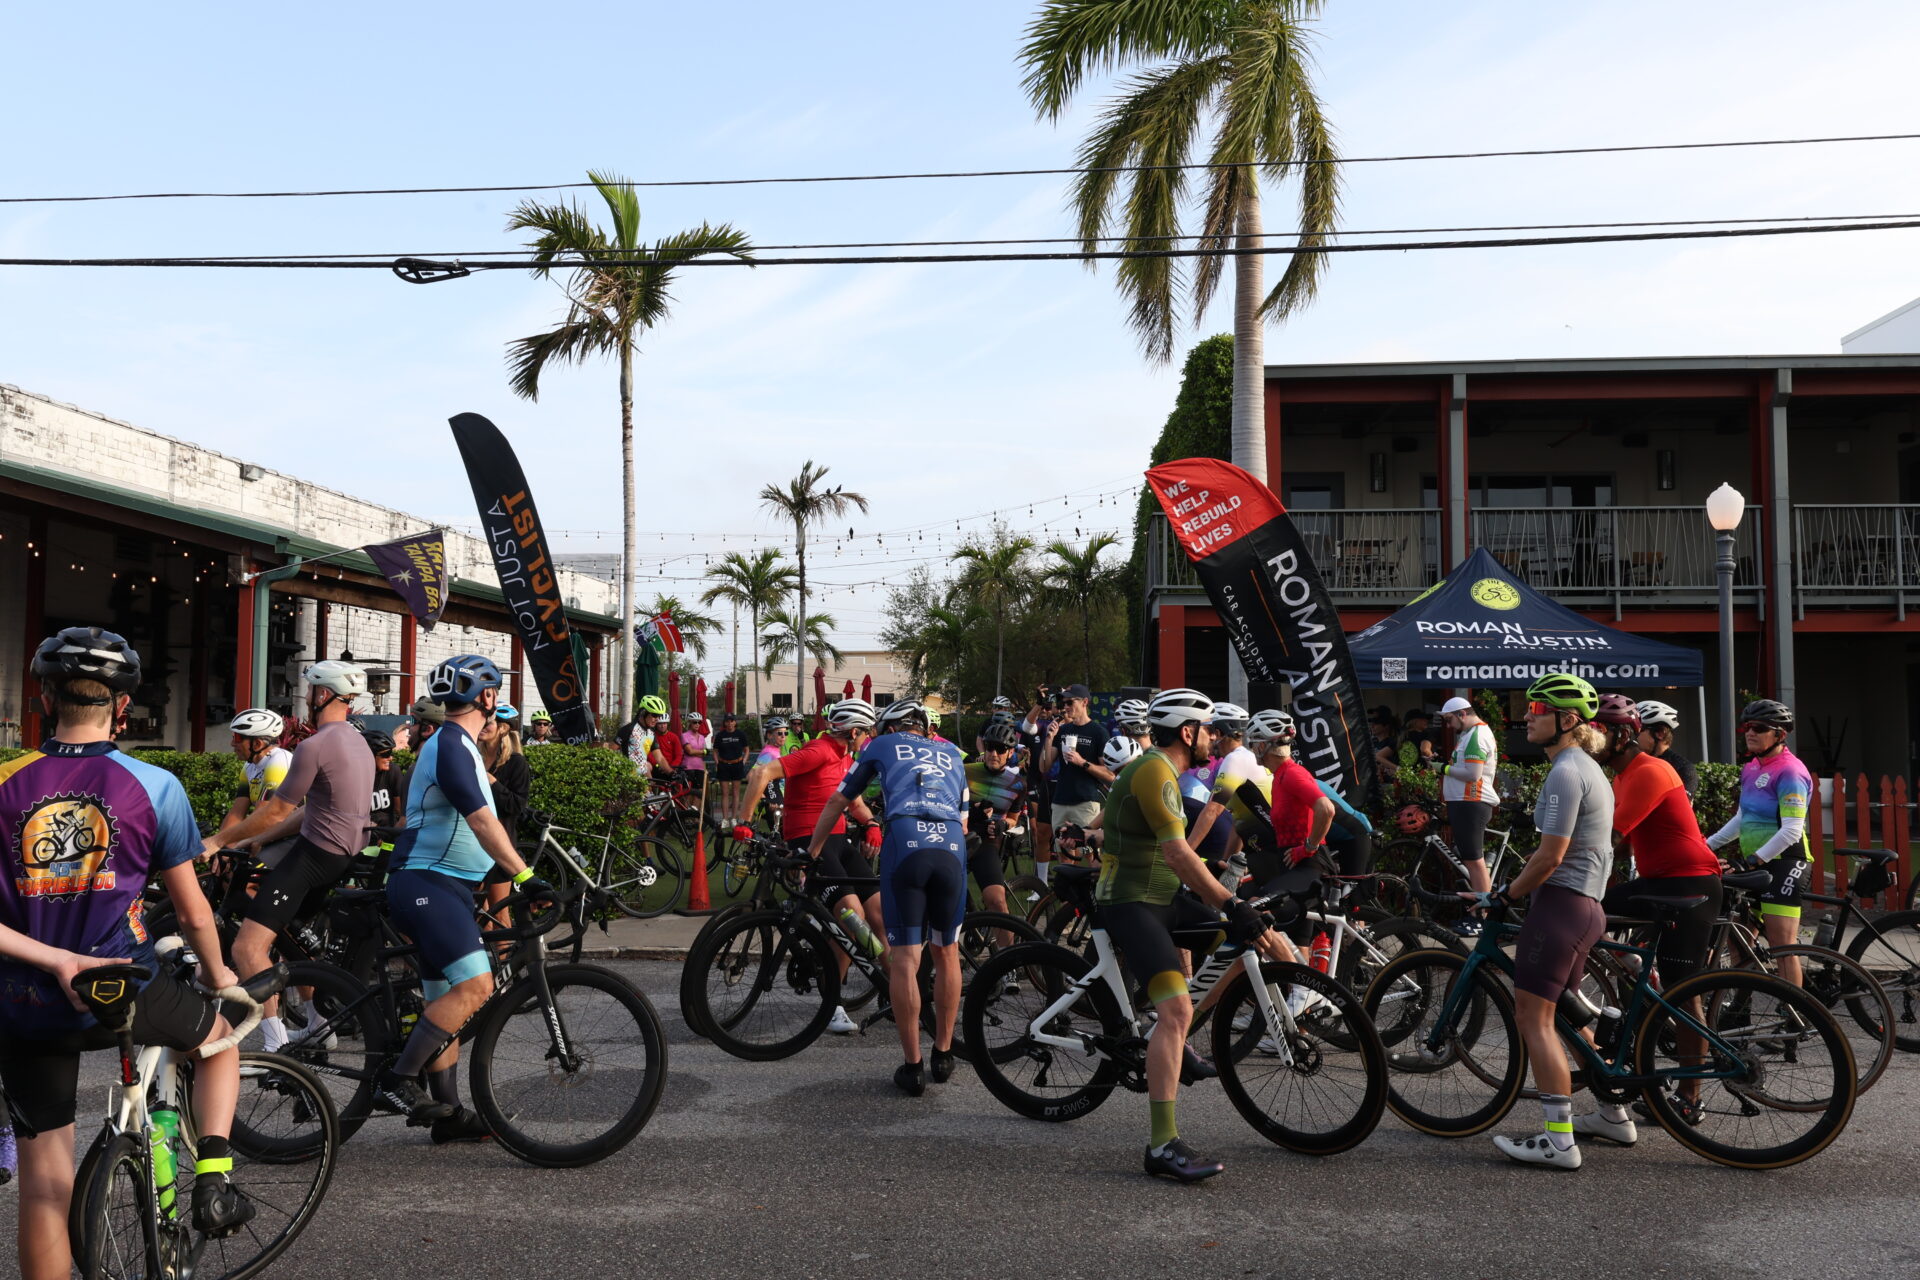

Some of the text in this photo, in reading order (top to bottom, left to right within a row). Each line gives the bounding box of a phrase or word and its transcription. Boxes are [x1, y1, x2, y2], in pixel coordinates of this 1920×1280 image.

[1164, 479, 1190, 499] WE
[1172, 490, 1210, 518] HELP
[1182, 495, 1242, 535] REBUILD
[1191, 523, 1233, 553] LIVES
[403, 543, 436, 583] TAMPA
[488, 498, 549, 651] NOT JUST A
[502, 490, 568, 643] CYCLIST
[1222, 585, 1239, 612] CAR
[1503, 584, 1519, 599] ROAD
[1267, 548, 1342, 693] ROMAN
[1416, 621, 1524, 635] ROMAN
[1503, 634, 1609, 647] AUSTIN
[1426, 658, 1660, 679] romanaustin.com
[1278, 668, 1348, 800] AUSTIN
[58, 744, 84, 754] FFW
[895, 744, 952, 771] B2B
[917, 821, 947, 833] B2B
[1781, 861, 1807, 896] SPBC
[1295, 971, 1328, 993] SWISS
[1267, 1005, 1289, 1056] CANYON
[1044, 1095, 1090, 1116] DT SWISS
